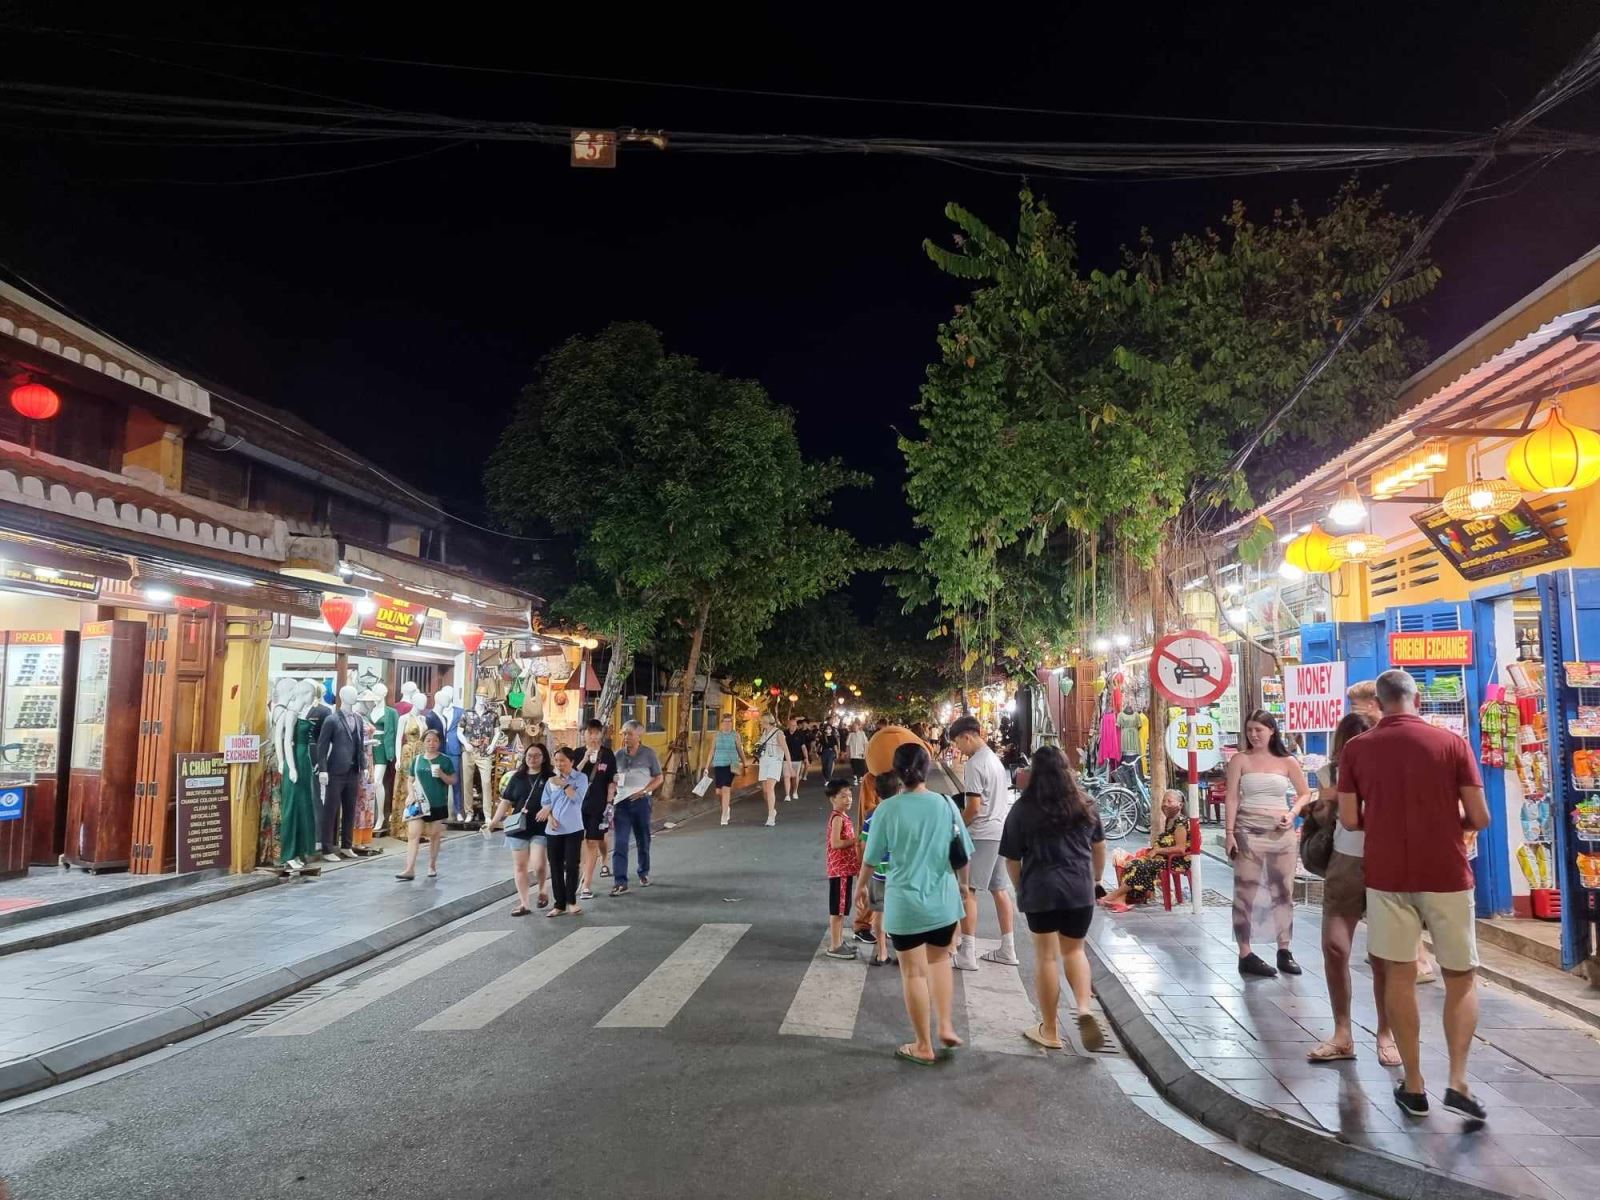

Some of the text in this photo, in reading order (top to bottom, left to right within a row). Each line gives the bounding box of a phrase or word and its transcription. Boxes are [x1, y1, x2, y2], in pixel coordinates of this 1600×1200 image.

[15, 632, 53, 642] PRADA
[1392, 636, 1468, 660] FOREIGN EXCHANGE
[1297, 665, 1332, 695] MONEY
[1289, 699, 1342, 730] EXCHANGE
[1178, 721, 1213, 735] Mni
[231, 738, 254, 748] MONEY
[1177, 737, 1213, 750] Mrt
[225, 749, 258, 760] EXCHANGE
